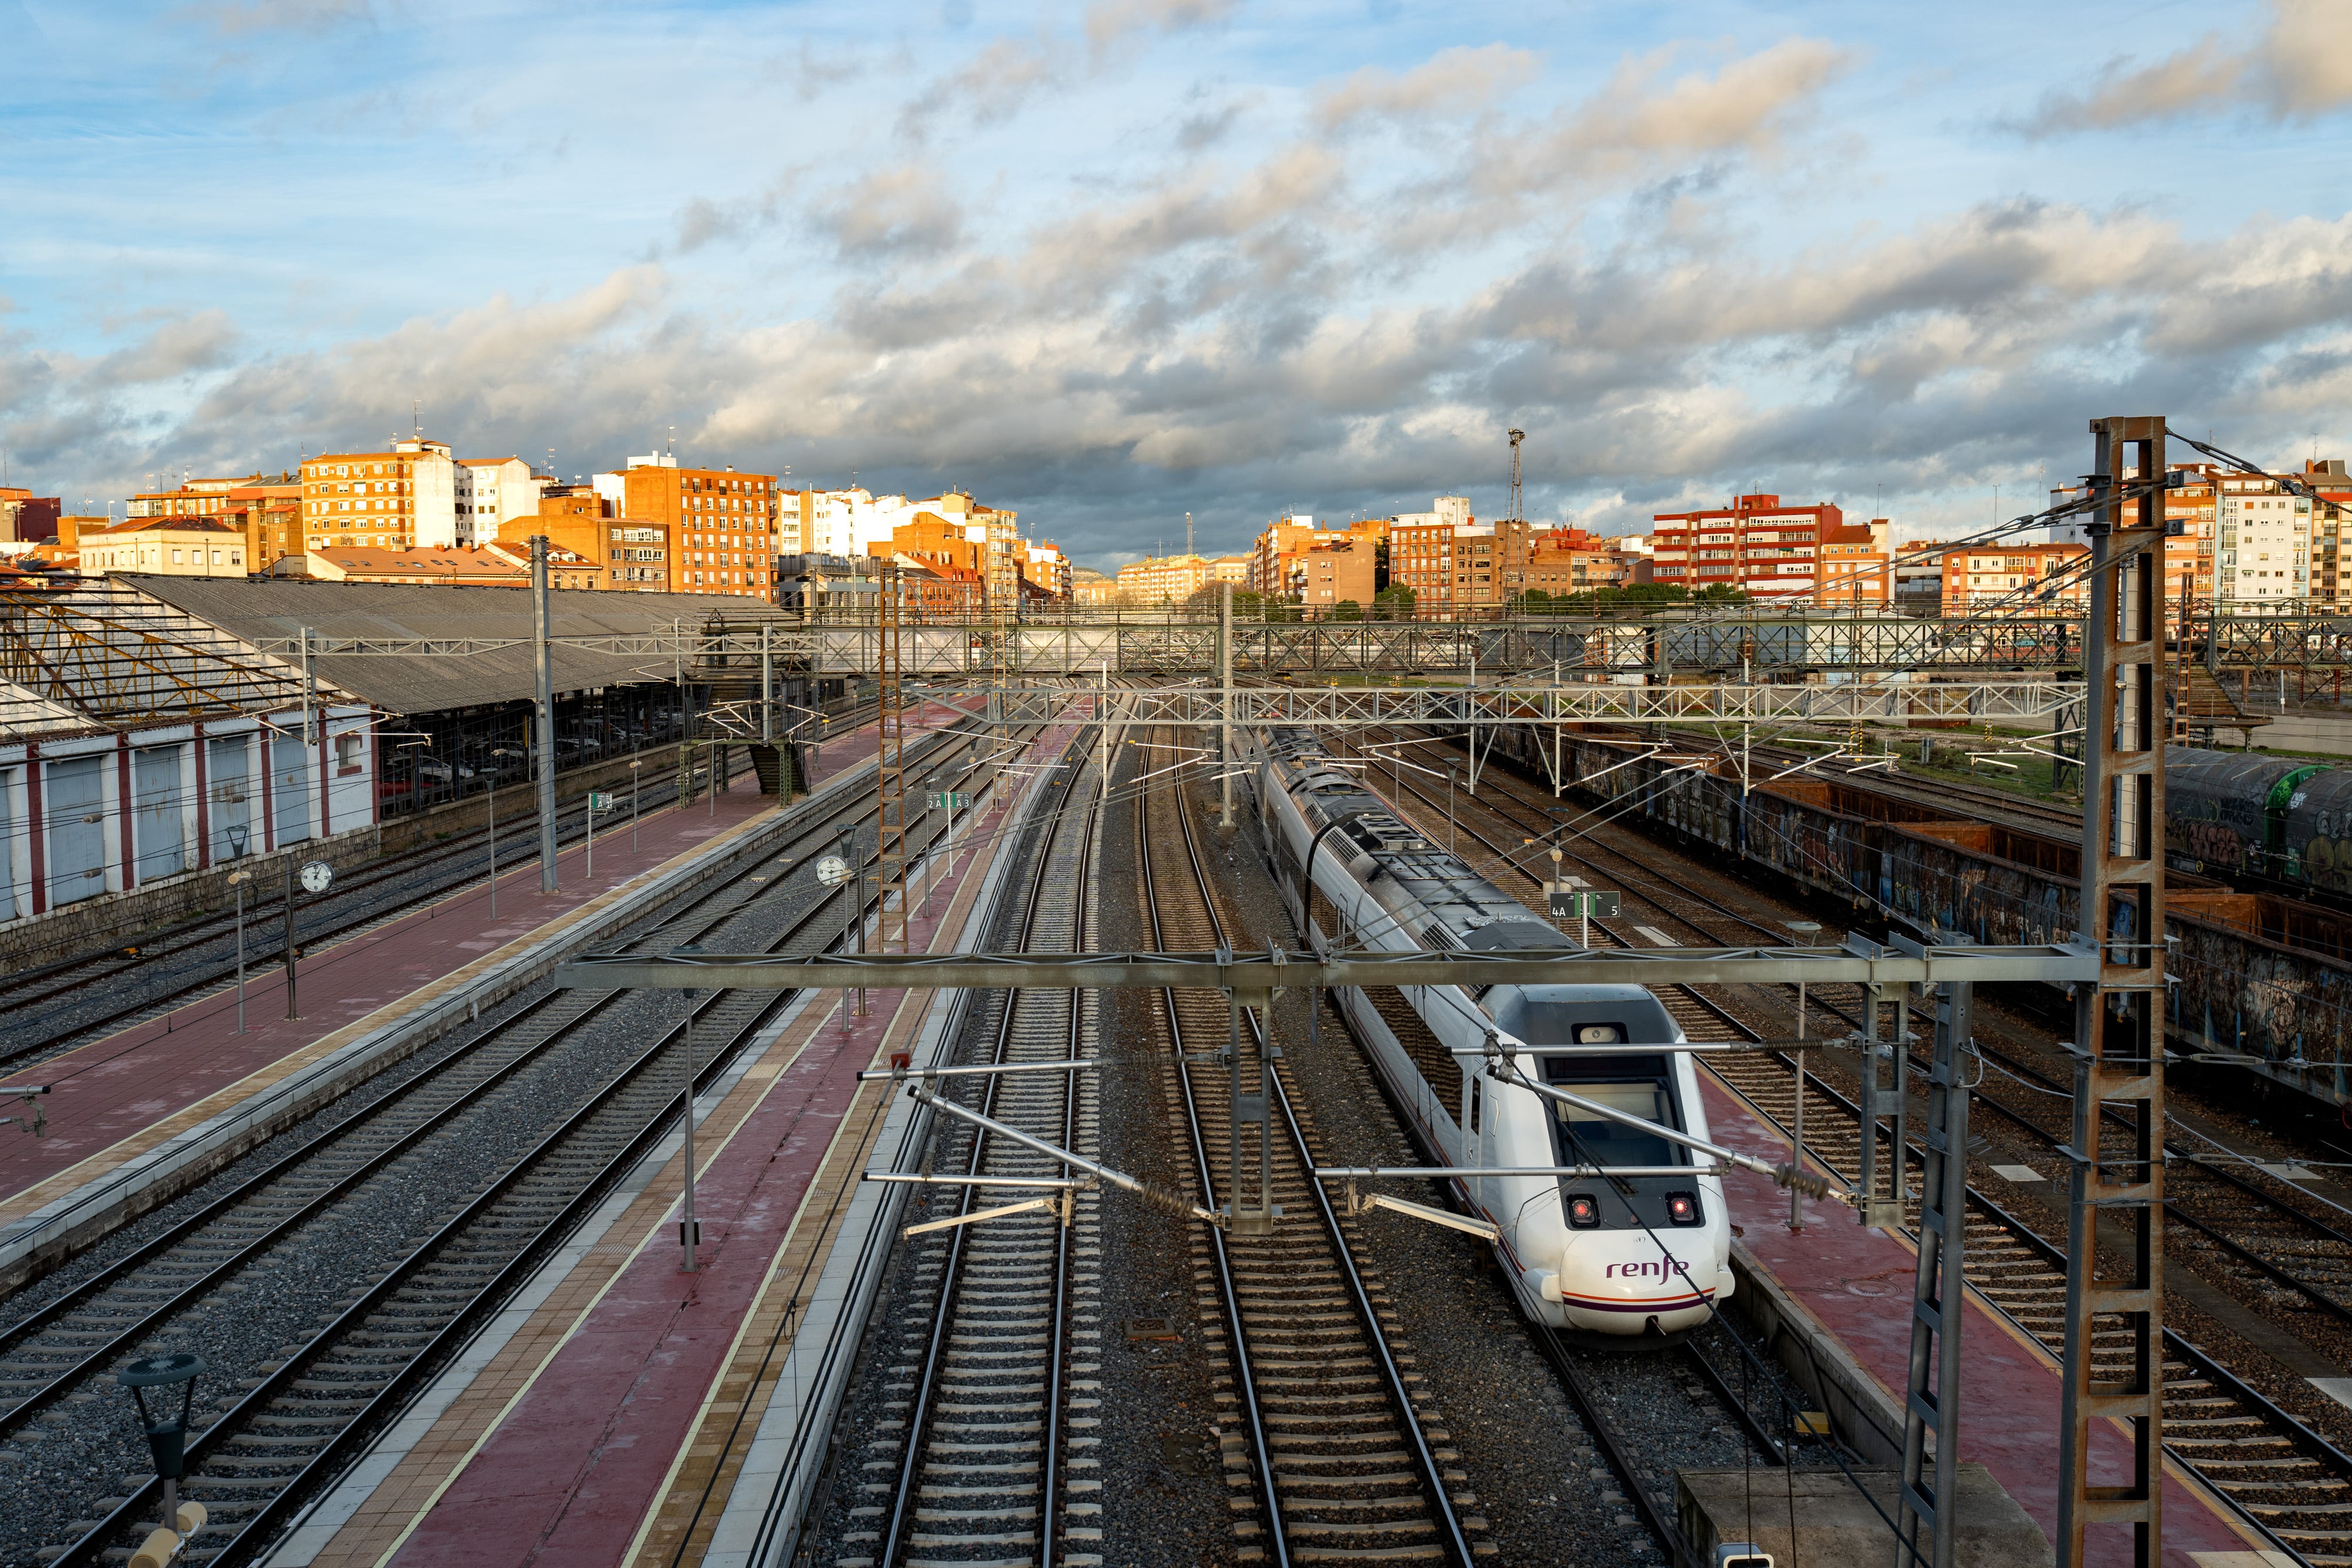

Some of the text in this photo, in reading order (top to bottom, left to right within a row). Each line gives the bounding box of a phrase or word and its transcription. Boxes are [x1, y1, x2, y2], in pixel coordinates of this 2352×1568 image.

[1552, 907, 1566, 917] 4A
[1612, 906, 1618, 916] 5
[1606, 1253, 1689, 1285] renfe
